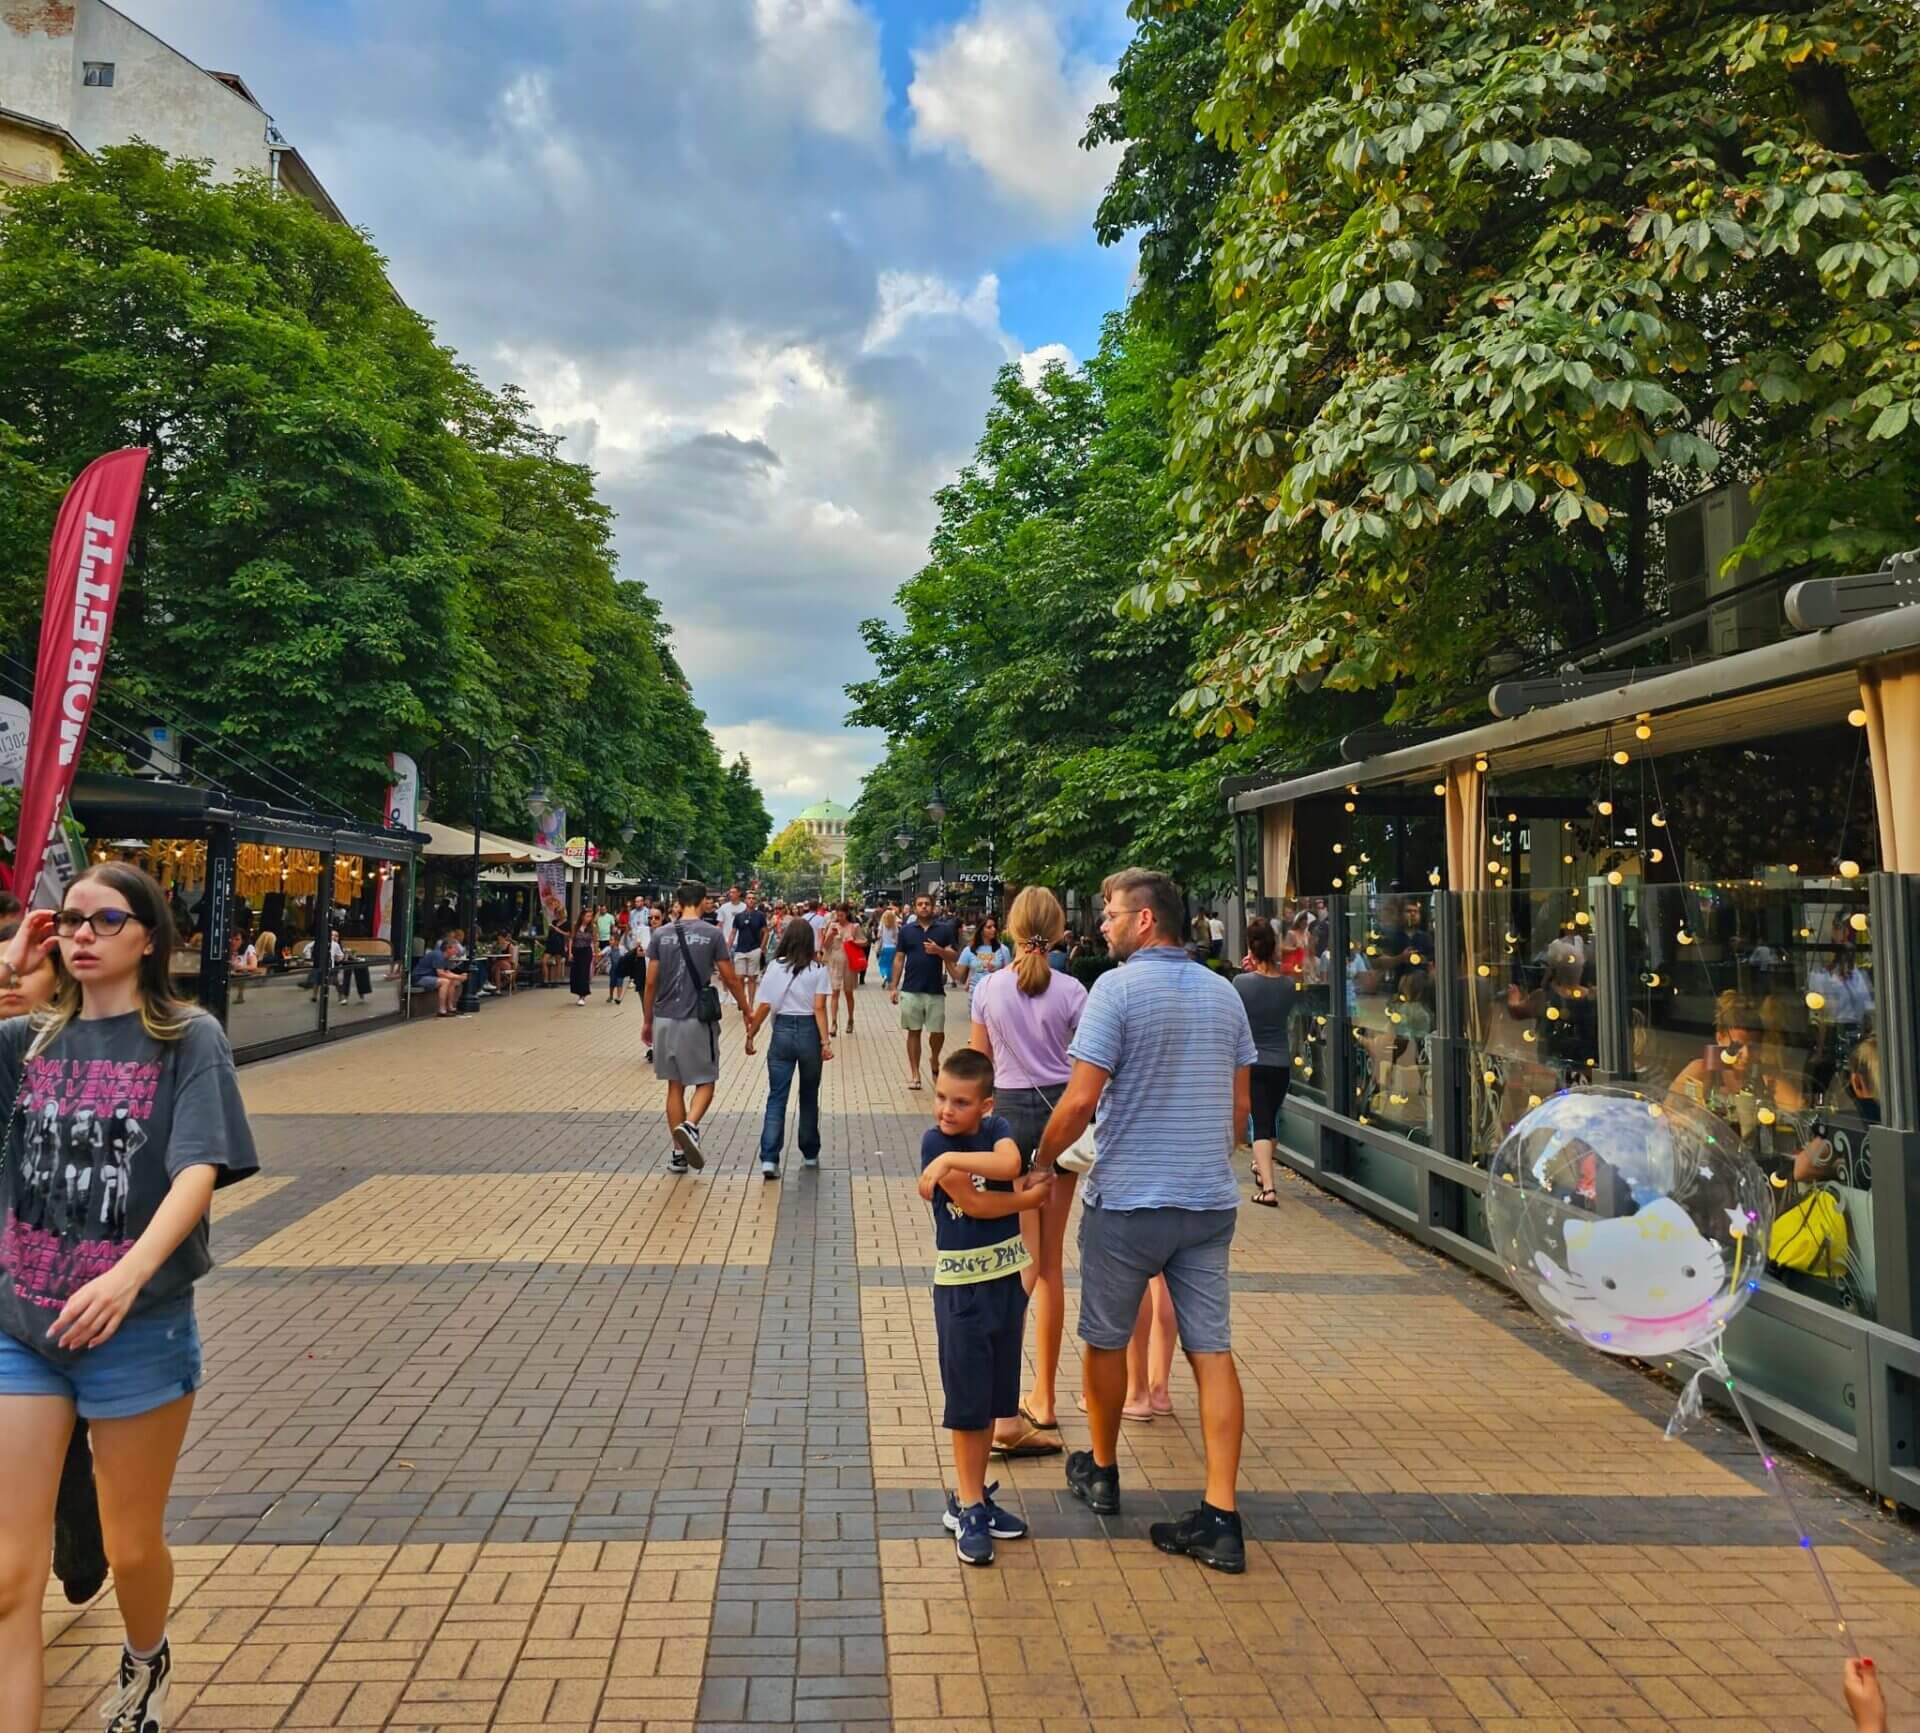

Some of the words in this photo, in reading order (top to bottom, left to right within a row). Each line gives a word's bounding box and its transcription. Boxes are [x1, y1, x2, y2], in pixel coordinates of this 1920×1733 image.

[58, 511, 115, 766] MORETTI
[72, 1059, 162, 1080] VENOM
[65, 1078, 158, 1099] VENOM
